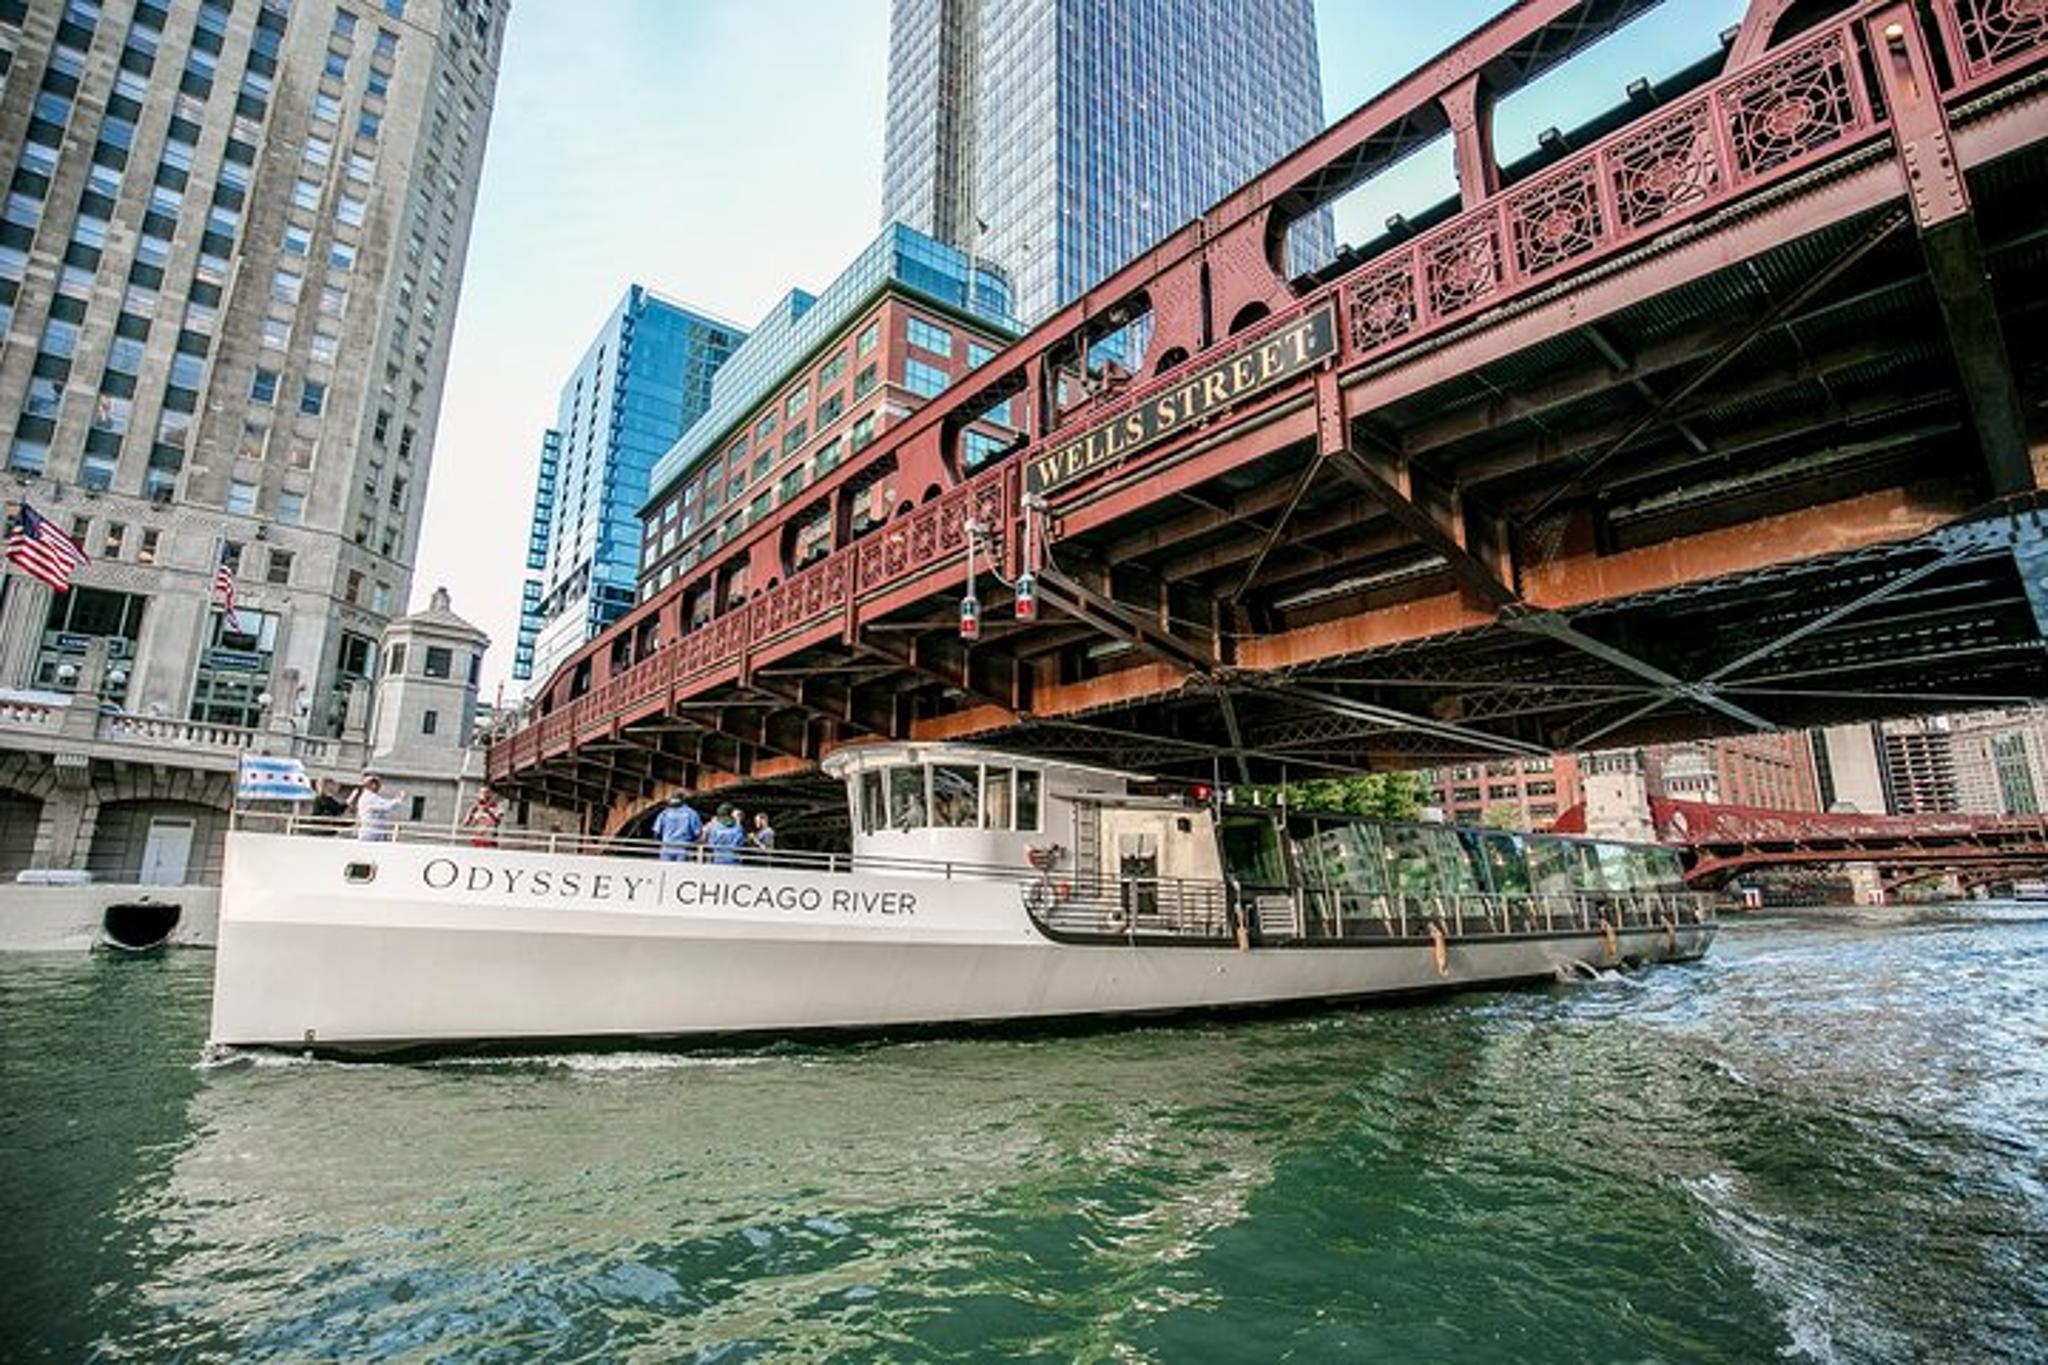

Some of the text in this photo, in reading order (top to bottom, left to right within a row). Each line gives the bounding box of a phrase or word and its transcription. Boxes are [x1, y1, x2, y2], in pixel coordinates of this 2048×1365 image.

[1036, 322, 1315, 487] WELLS STREET
[423, 858, 917, 915] ODYSSEY CHICAGO RIVER
